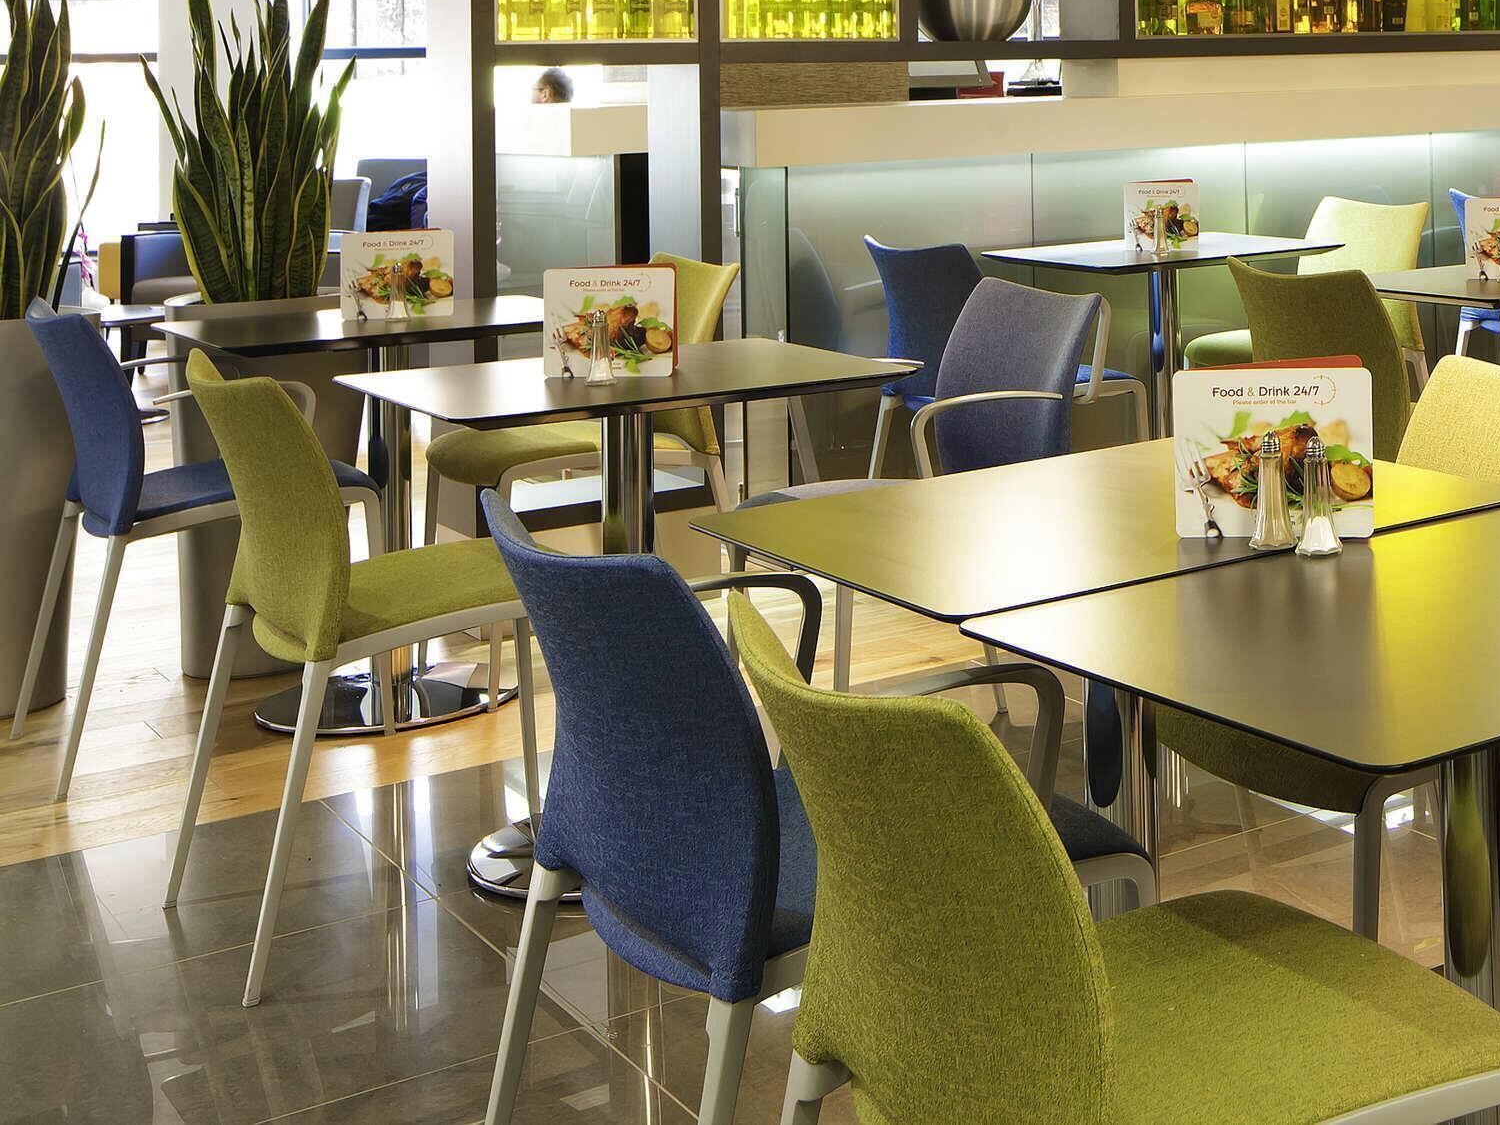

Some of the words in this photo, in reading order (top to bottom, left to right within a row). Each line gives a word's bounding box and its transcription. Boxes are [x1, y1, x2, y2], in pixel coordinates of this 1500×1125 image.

[1212, 387, 1243, 397] Food
[1247, 386, 1254, 397] &
[1259, 386, 1290, 396] Drink
[1293, 385, 1319, 396] 24/7
